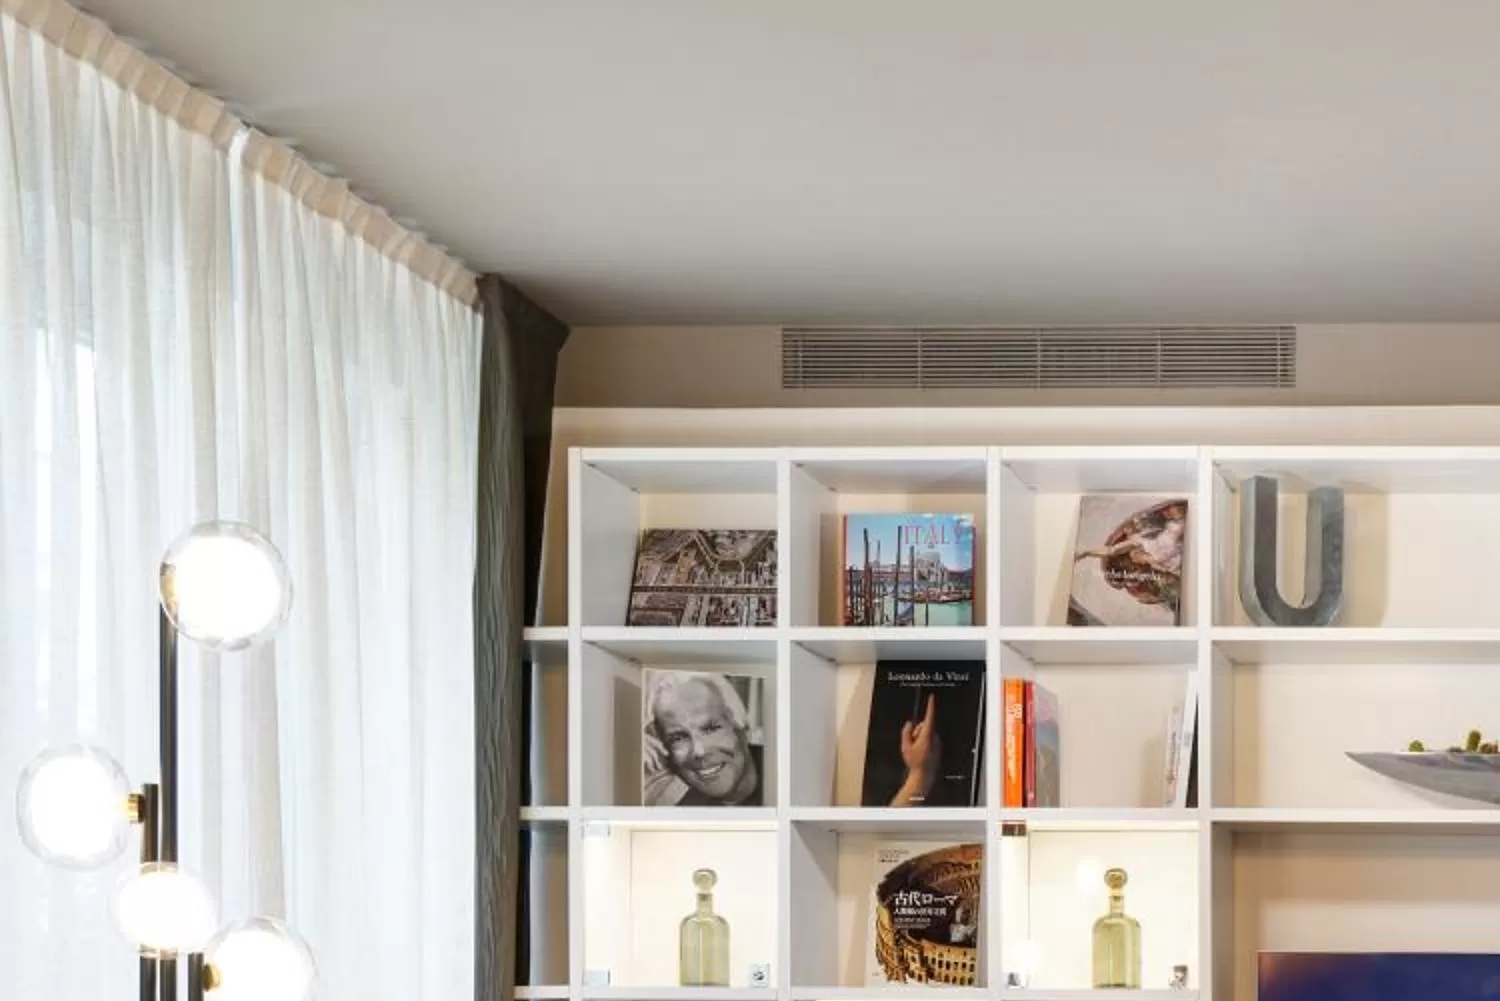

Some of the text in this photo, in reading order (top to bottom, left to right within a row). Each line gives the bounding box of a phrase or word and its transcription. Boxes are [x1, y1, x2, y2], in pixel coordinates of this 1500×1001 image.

[904, 523, 964, 545] ITALY
[887, 671, 969, 681] Leonardo da Vinci
